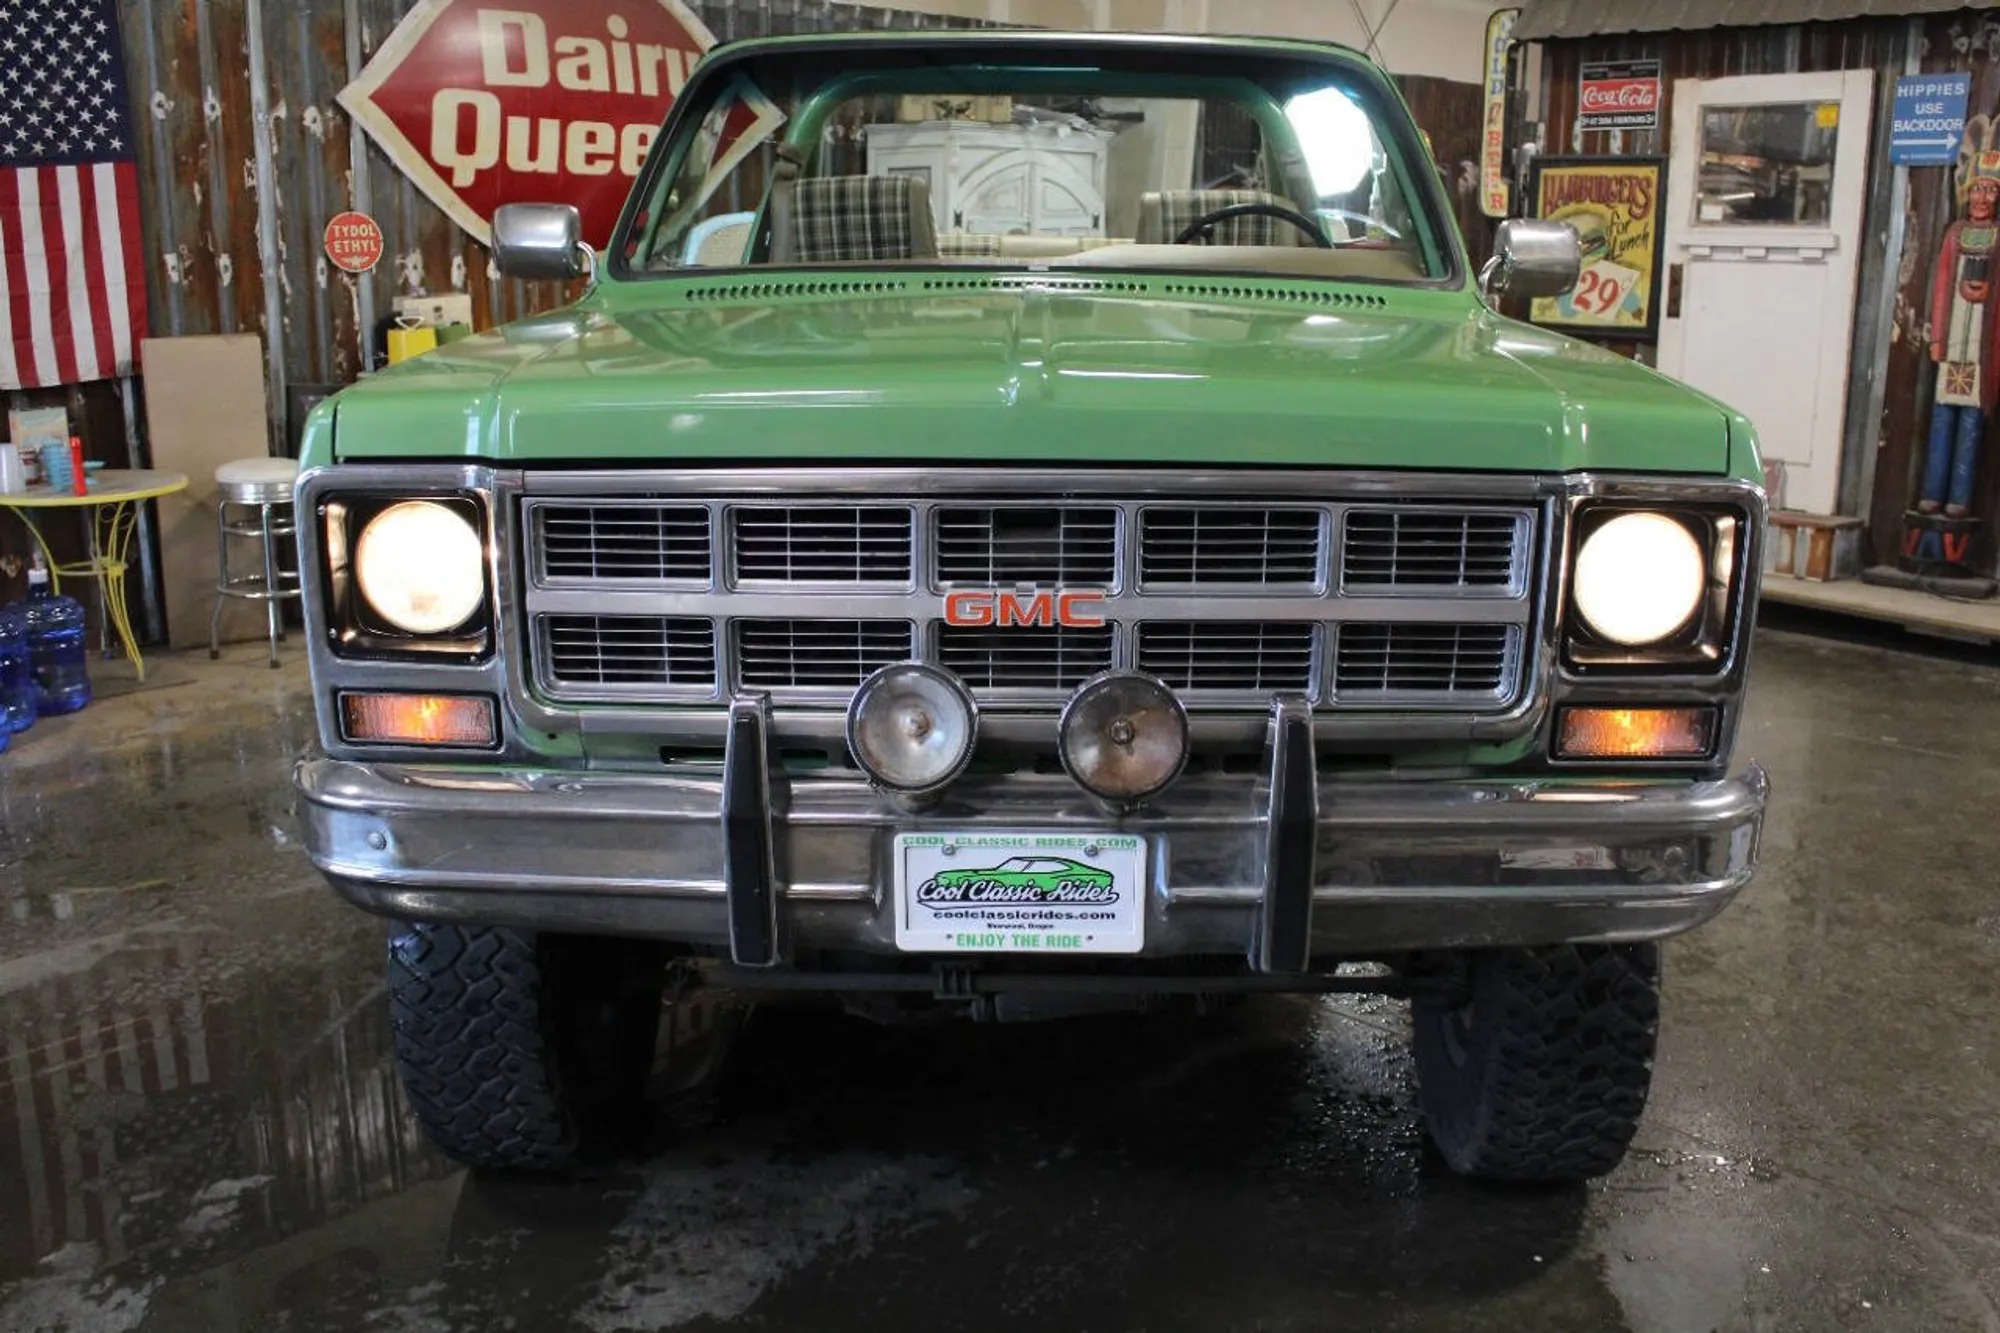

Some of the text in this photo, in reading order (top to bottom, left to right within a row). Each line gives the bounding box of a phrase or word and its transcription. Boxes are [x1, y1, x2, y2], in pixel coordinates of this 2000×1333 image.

[1583, 84, 1653, 107] Coca-Cola
[1898, 82, 1965, 97] HIPPIES
[1915, 103, 1945, 115] USE
[1893, 119, 1964, 132] BACKDOOR
[431, 87, 661, 188] Quee
[1542, 173, 1653, 221] HAMBURGERS
[332, 224, 377, 238] TYDOL
[334, 240, 378, 253] ETHYL
[944, 591, 1106, 627] GMC
[902, 836, 946, 846] COOL
[955, 836, 1030, 847] CLASSIC
[919, 880, 1118, 901] Cool Classic Rides
[933, 909, 1116, 920] coolclassicrides.com
[955, 933, 1082, 948] ENJOY THE RIDE
